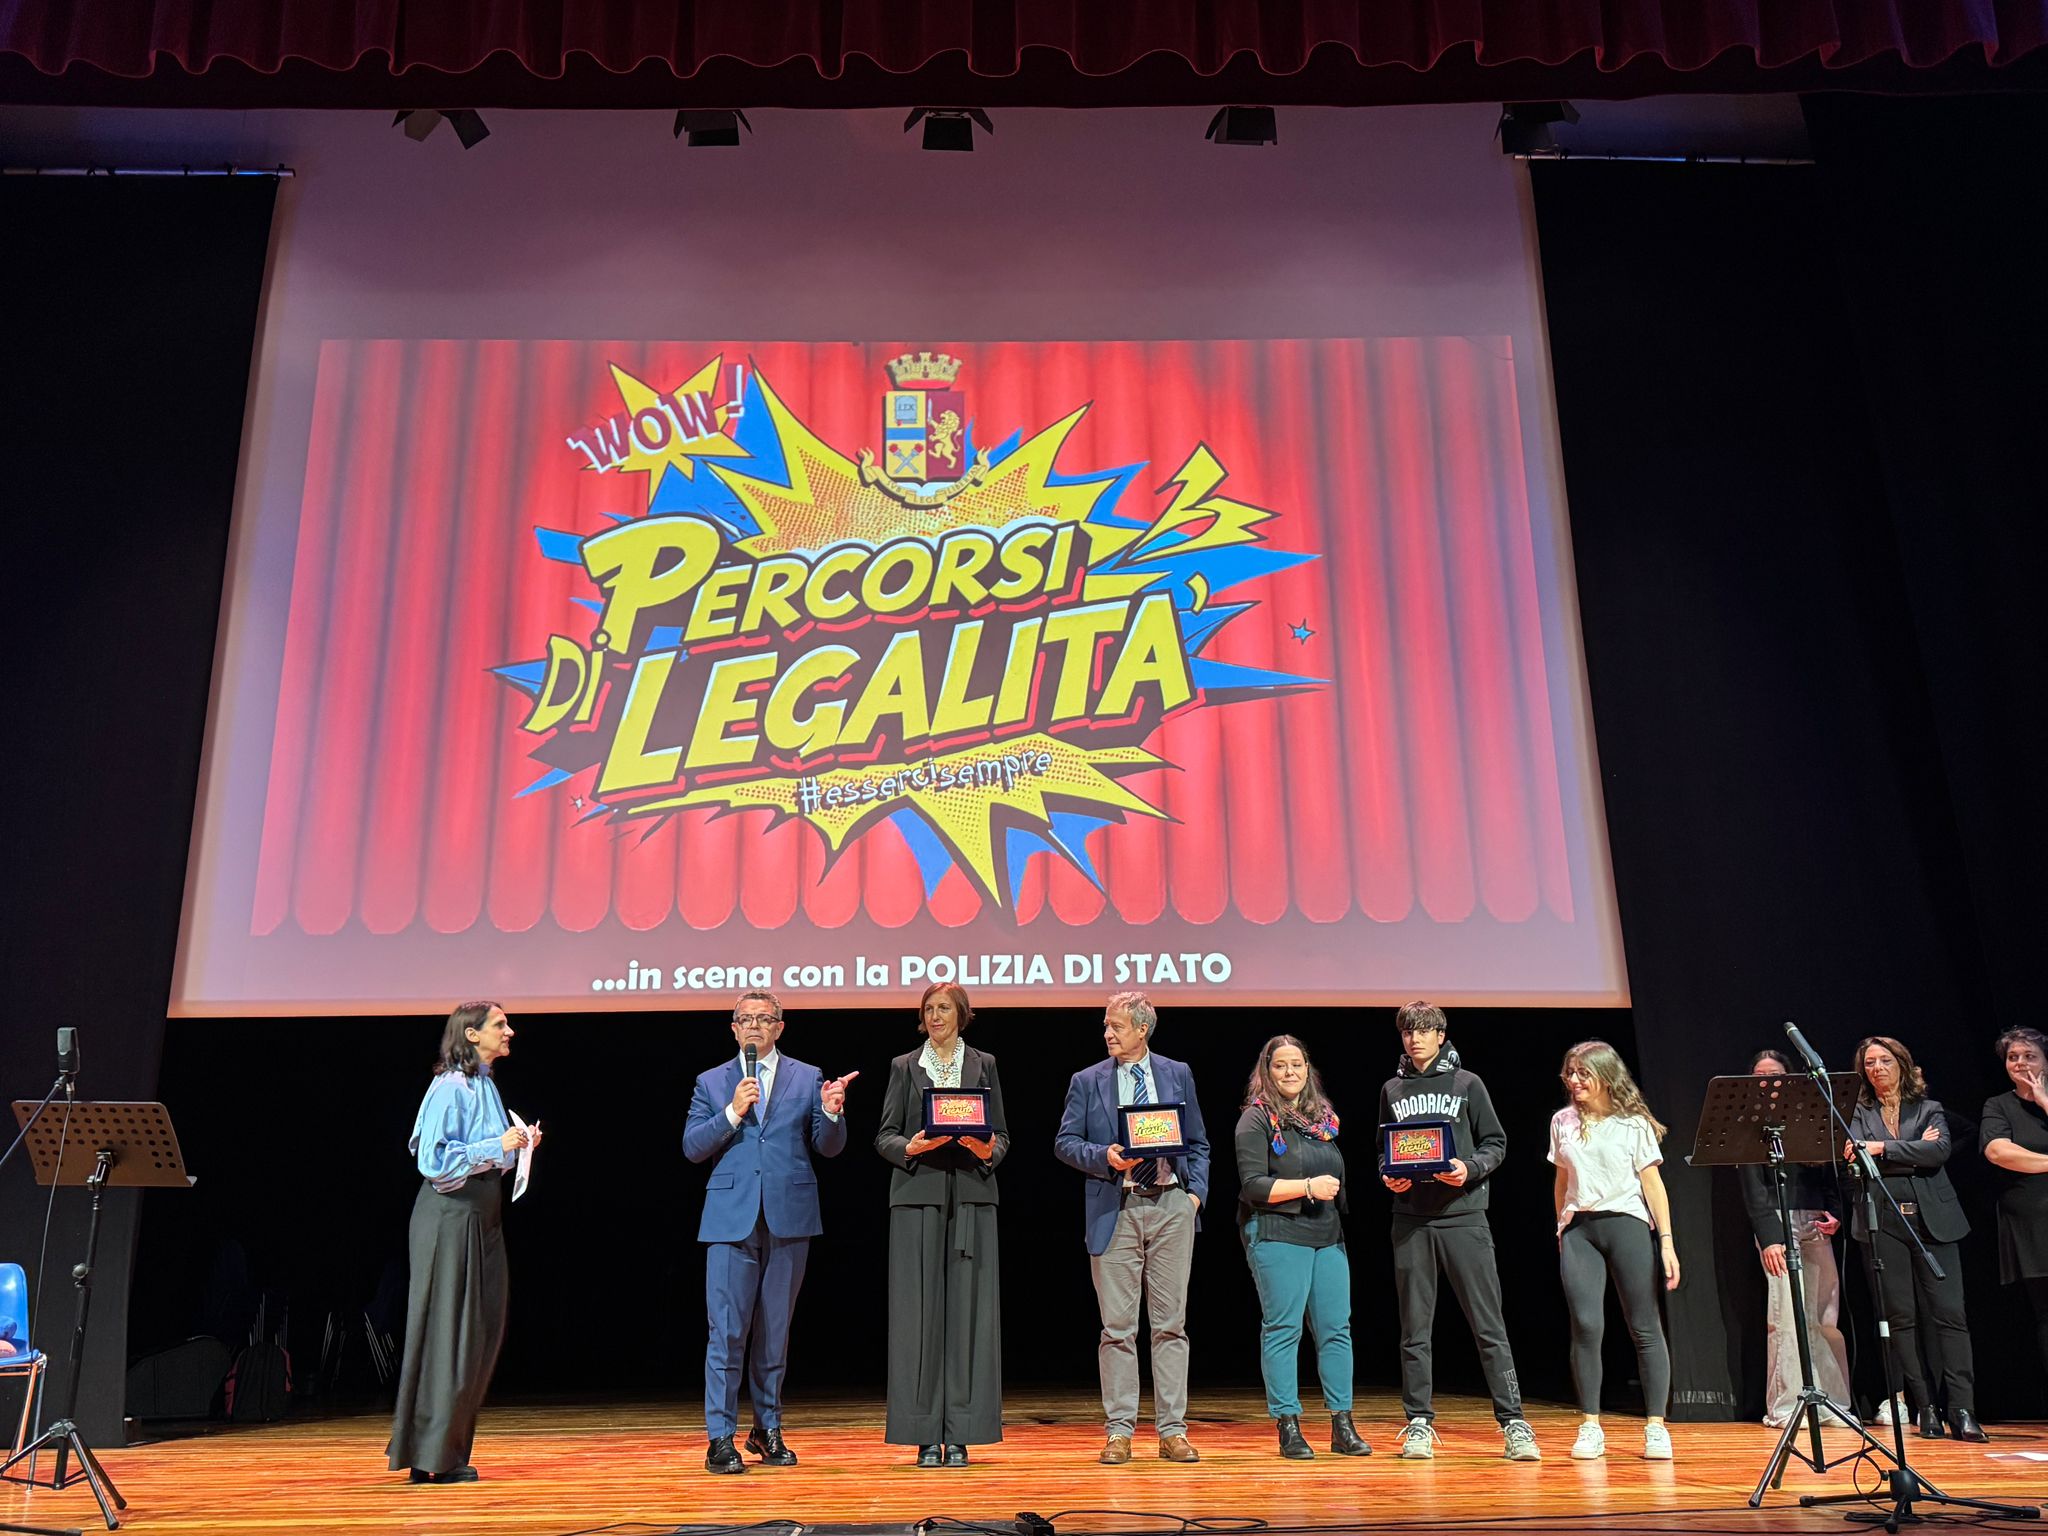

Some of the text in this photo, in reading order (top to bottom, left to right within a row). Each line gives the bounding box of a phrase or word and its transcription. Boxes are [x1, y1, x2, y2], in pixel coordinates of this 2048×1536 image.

[565, 362, 745, 474] WOW!
[798, 749, 1052, 817] #essercisempre
[673, 966, 772, 989] scena
[783, 965, 844, 988] con
[856, 956, 889, 986] la
[901, 955, 1054, 985] POLIZIA
[1064, 953, 1103, 984] DI
[1114, 952, 1232, 983] STATO
[1391, 1093, 1461, 1122] HOODRICH
